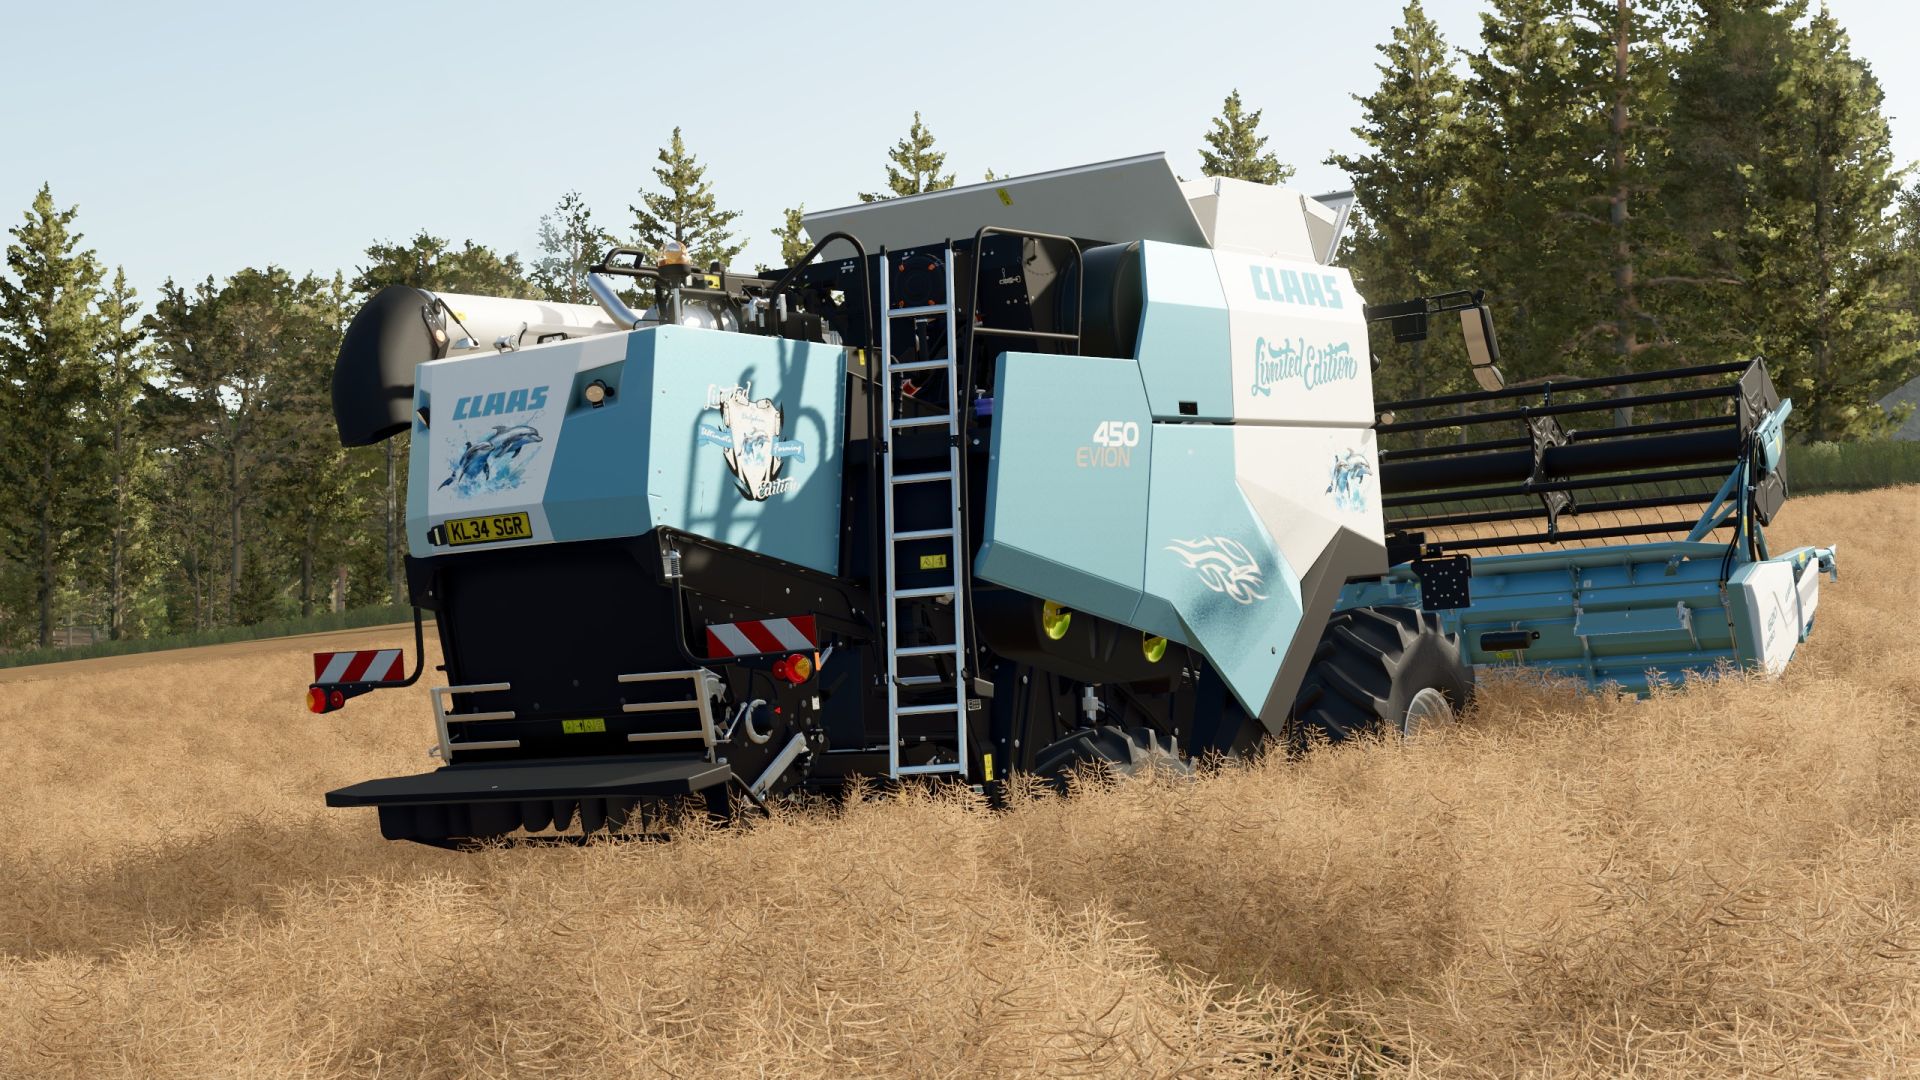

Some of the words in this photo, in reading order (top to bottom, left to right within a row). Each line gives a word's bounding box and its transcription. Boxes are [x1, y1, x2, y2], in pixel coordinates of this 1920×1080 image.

[1250, 265, 1343, 309] CLAAS
[1251, 336, 1304, 397] Limited
[1304, 342, 1358, 391] Edition
[452, 385, 549, 421] CLAAS
[1093, 420, 1139, 447] 450
[1075, 446, 1131, 468] EVION
[451, 520, 489, 541] KL34
[495, 516, 523, 536] SGR
